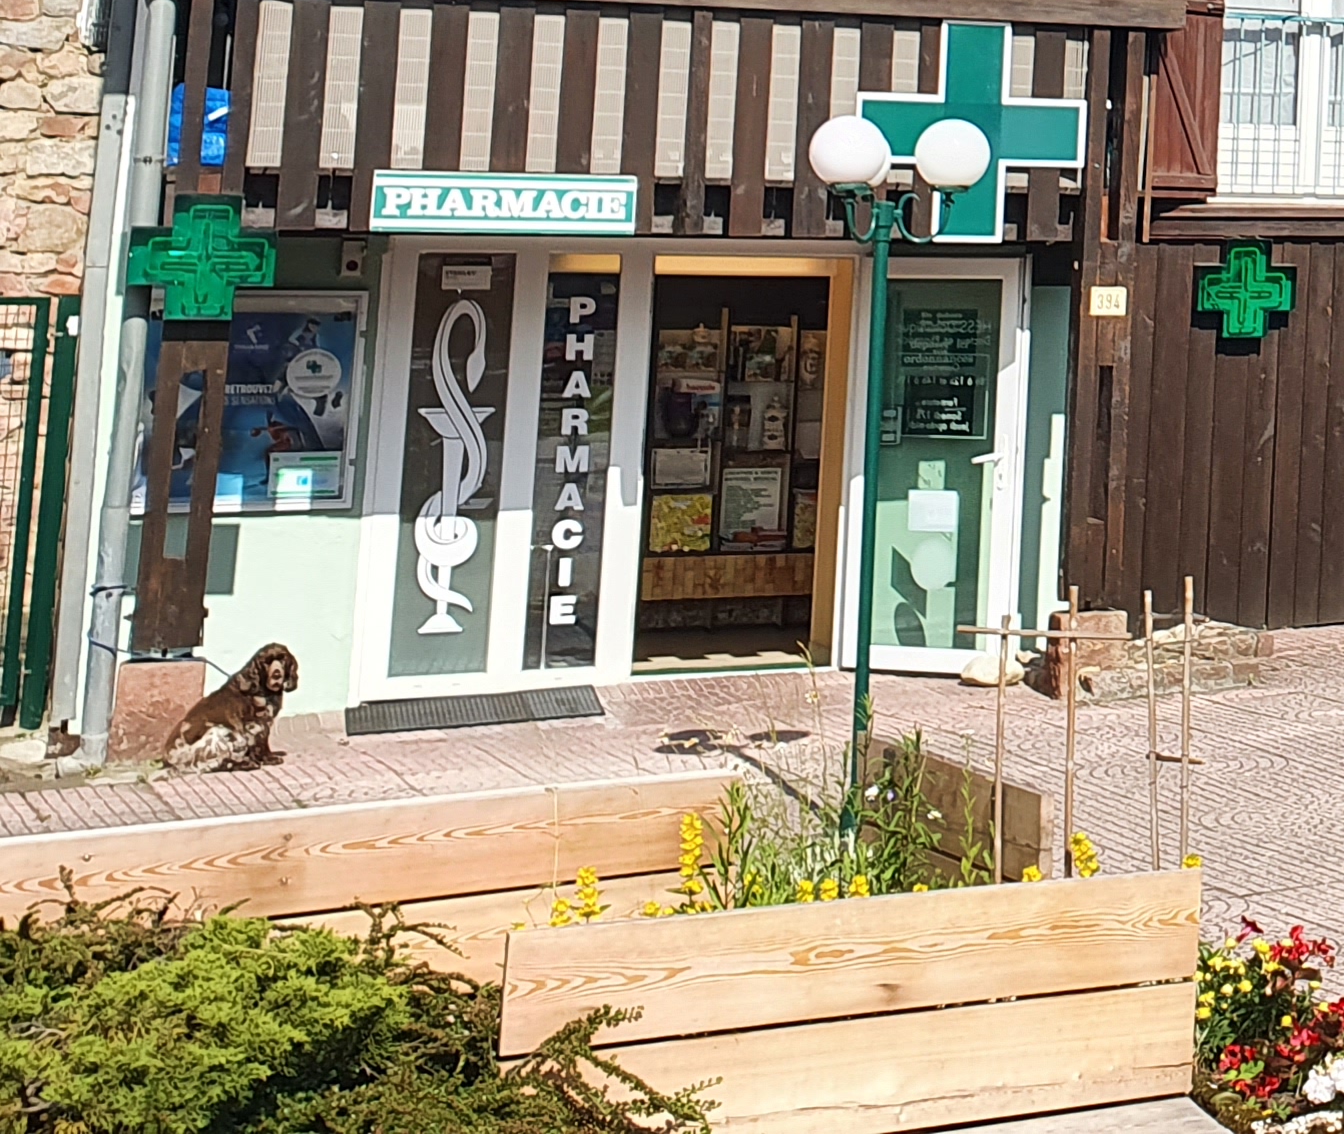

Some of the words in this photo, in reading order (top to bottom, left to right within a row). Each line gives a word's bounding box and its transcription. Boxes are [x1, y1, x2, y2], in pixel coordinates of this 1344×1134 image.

[381, 187, 627, 220] PHARMACIE
[1097, 293, 1120, 309] 394
[225, 384, 273, 394] RETROUVEZ
[549, 296, 597, 626] PHARMACIE
